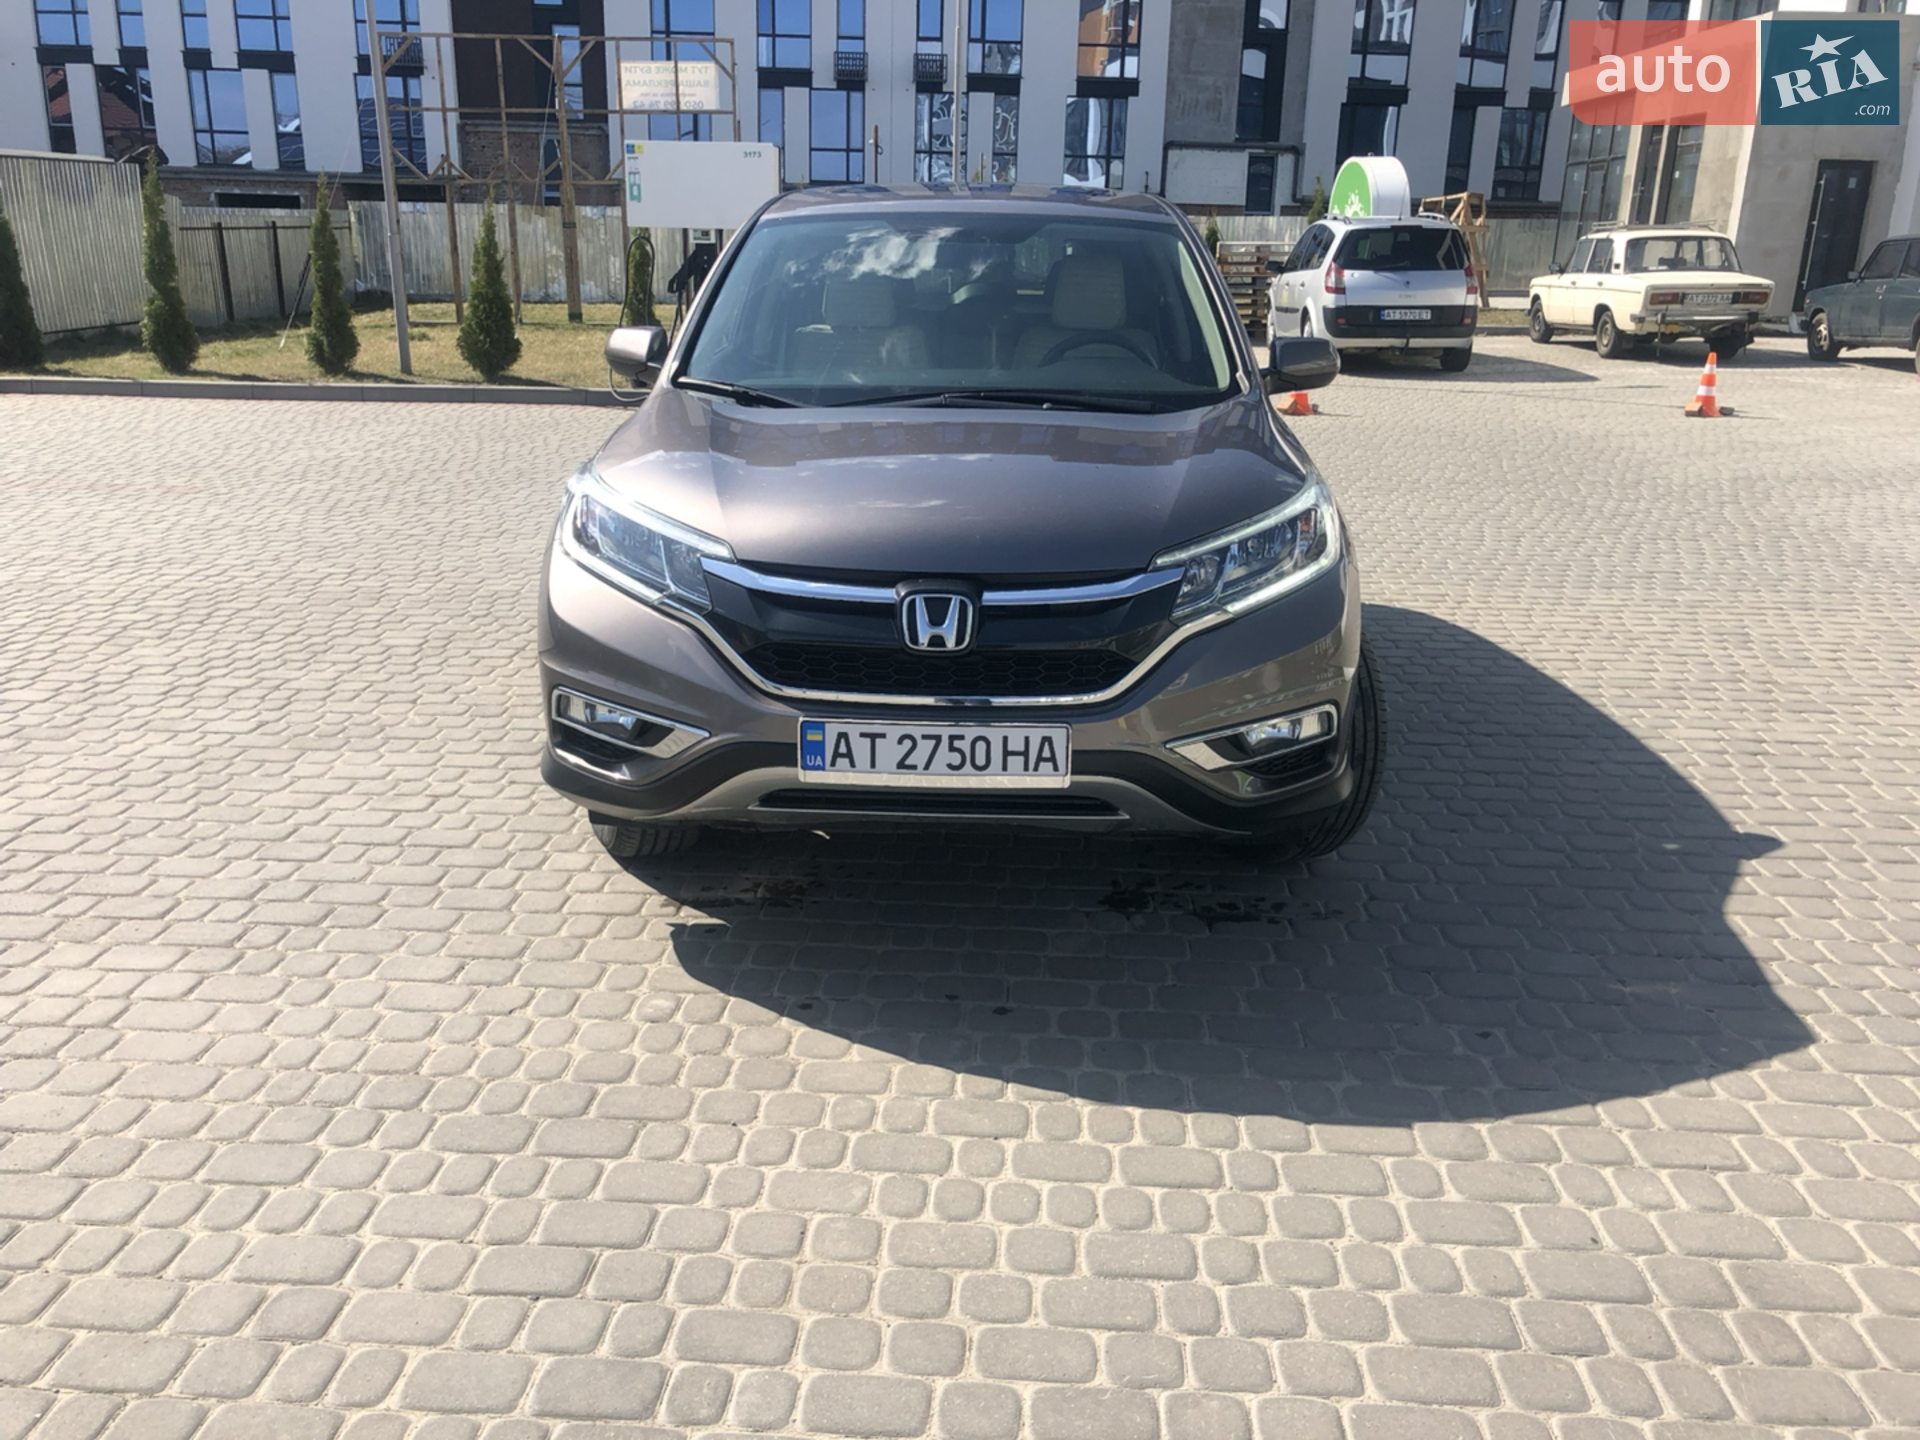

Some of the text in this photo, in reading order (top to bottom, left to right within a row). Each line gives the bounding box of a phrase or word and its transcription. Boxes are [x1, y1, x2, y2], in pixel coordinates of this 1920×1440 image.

[1386, 311, 1397, 319] AT
[829, 731, 1060, 773] AT 2750 HA
[806, 755, 824, 767] UA
